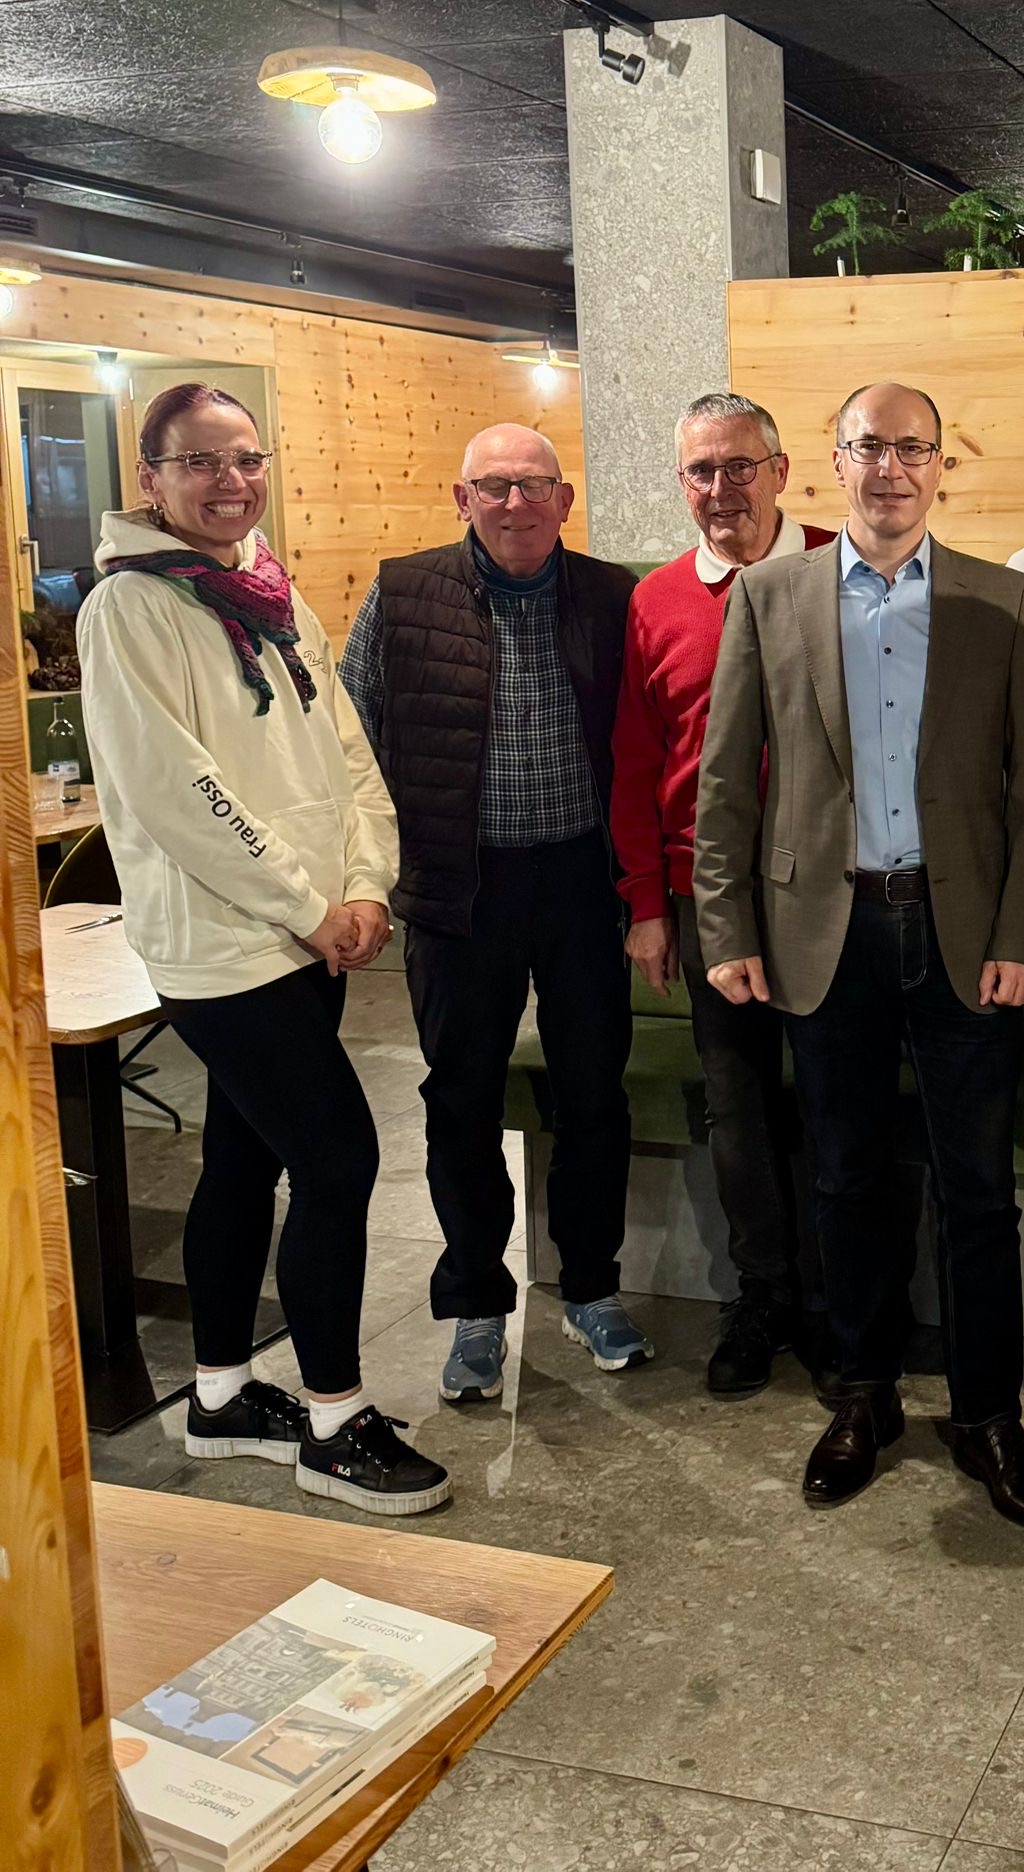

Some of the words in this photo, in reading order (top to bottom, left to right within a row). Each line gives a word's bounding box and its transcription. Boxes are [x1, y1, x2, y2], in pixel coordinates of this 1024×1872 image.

[192, 775, 232, 817] Ossi
[228, 815, 267, 858] Frau
[354, 1414, 373, 1430] FILA
[331, 1462, 351, 1477] FILA
[342, 1615, 415, 1643] RINGHOTELS
[187, 1779, 223, 1796] 2025
[222, 1789, 255, 1809] Guide
